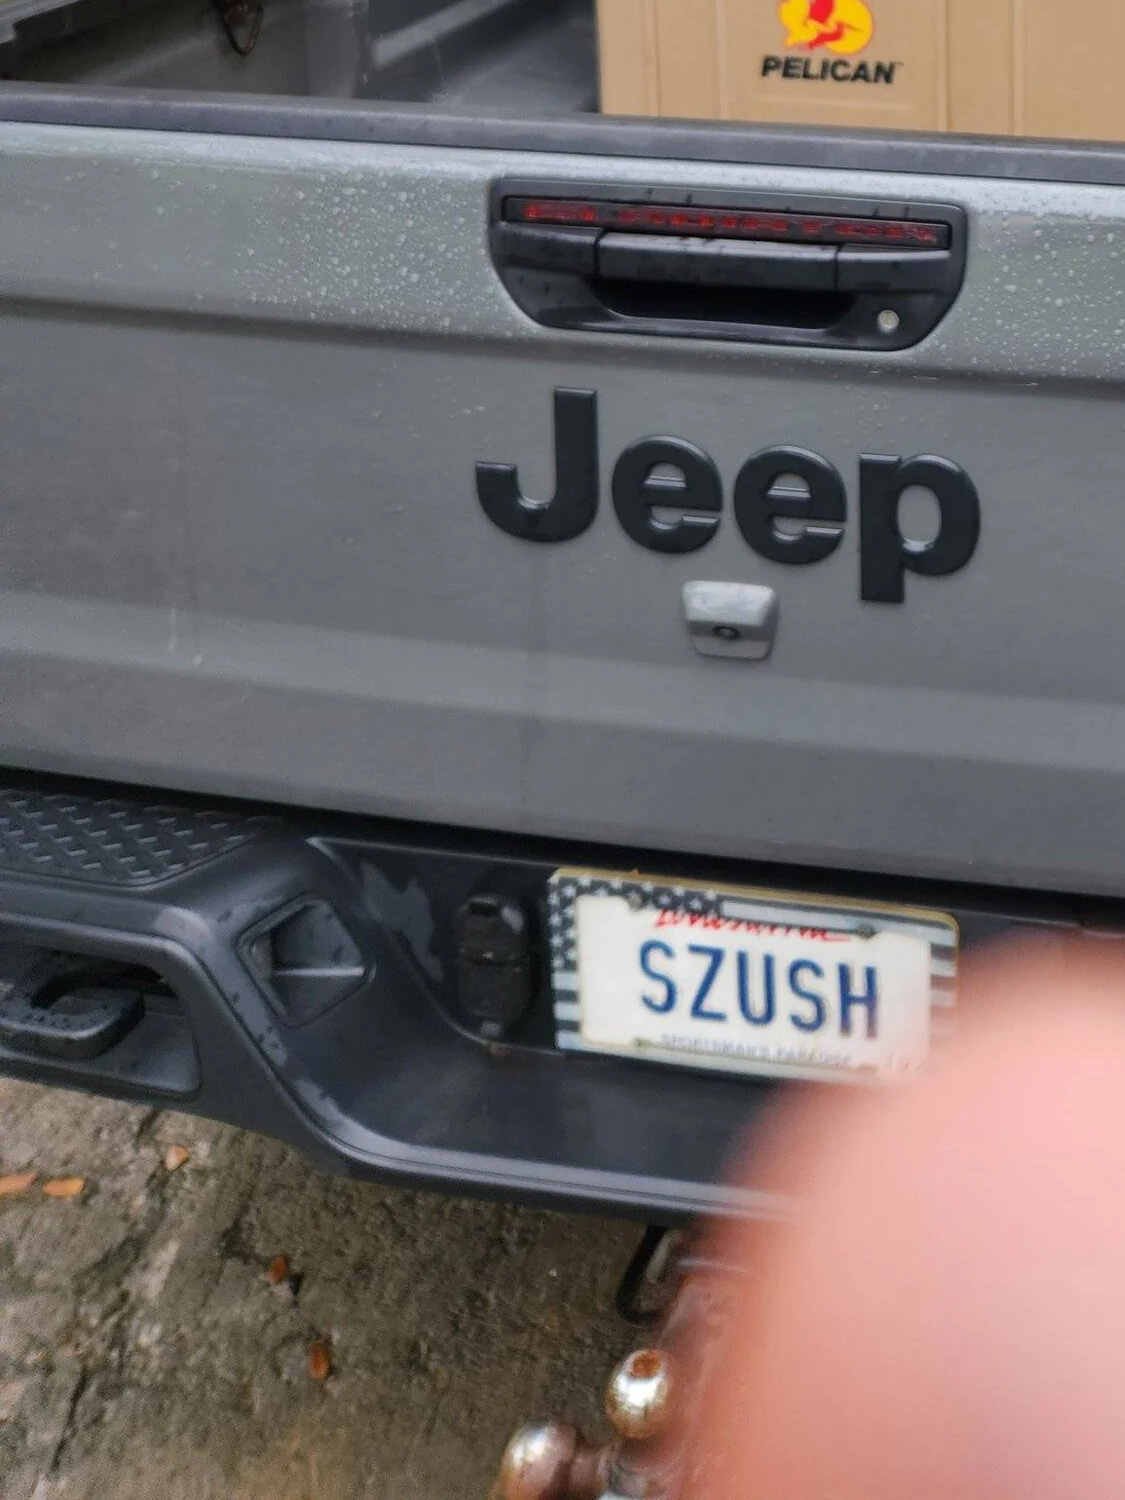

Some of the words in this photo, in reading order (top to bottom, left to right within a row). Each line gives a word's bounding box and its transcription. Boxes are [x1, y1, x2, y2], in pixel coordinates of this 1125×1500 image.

[760, 54, 896, 84] PELICAN
[475, 386, 981, 604] Jeep
[638, 939, 879, 1040] SZUSH
